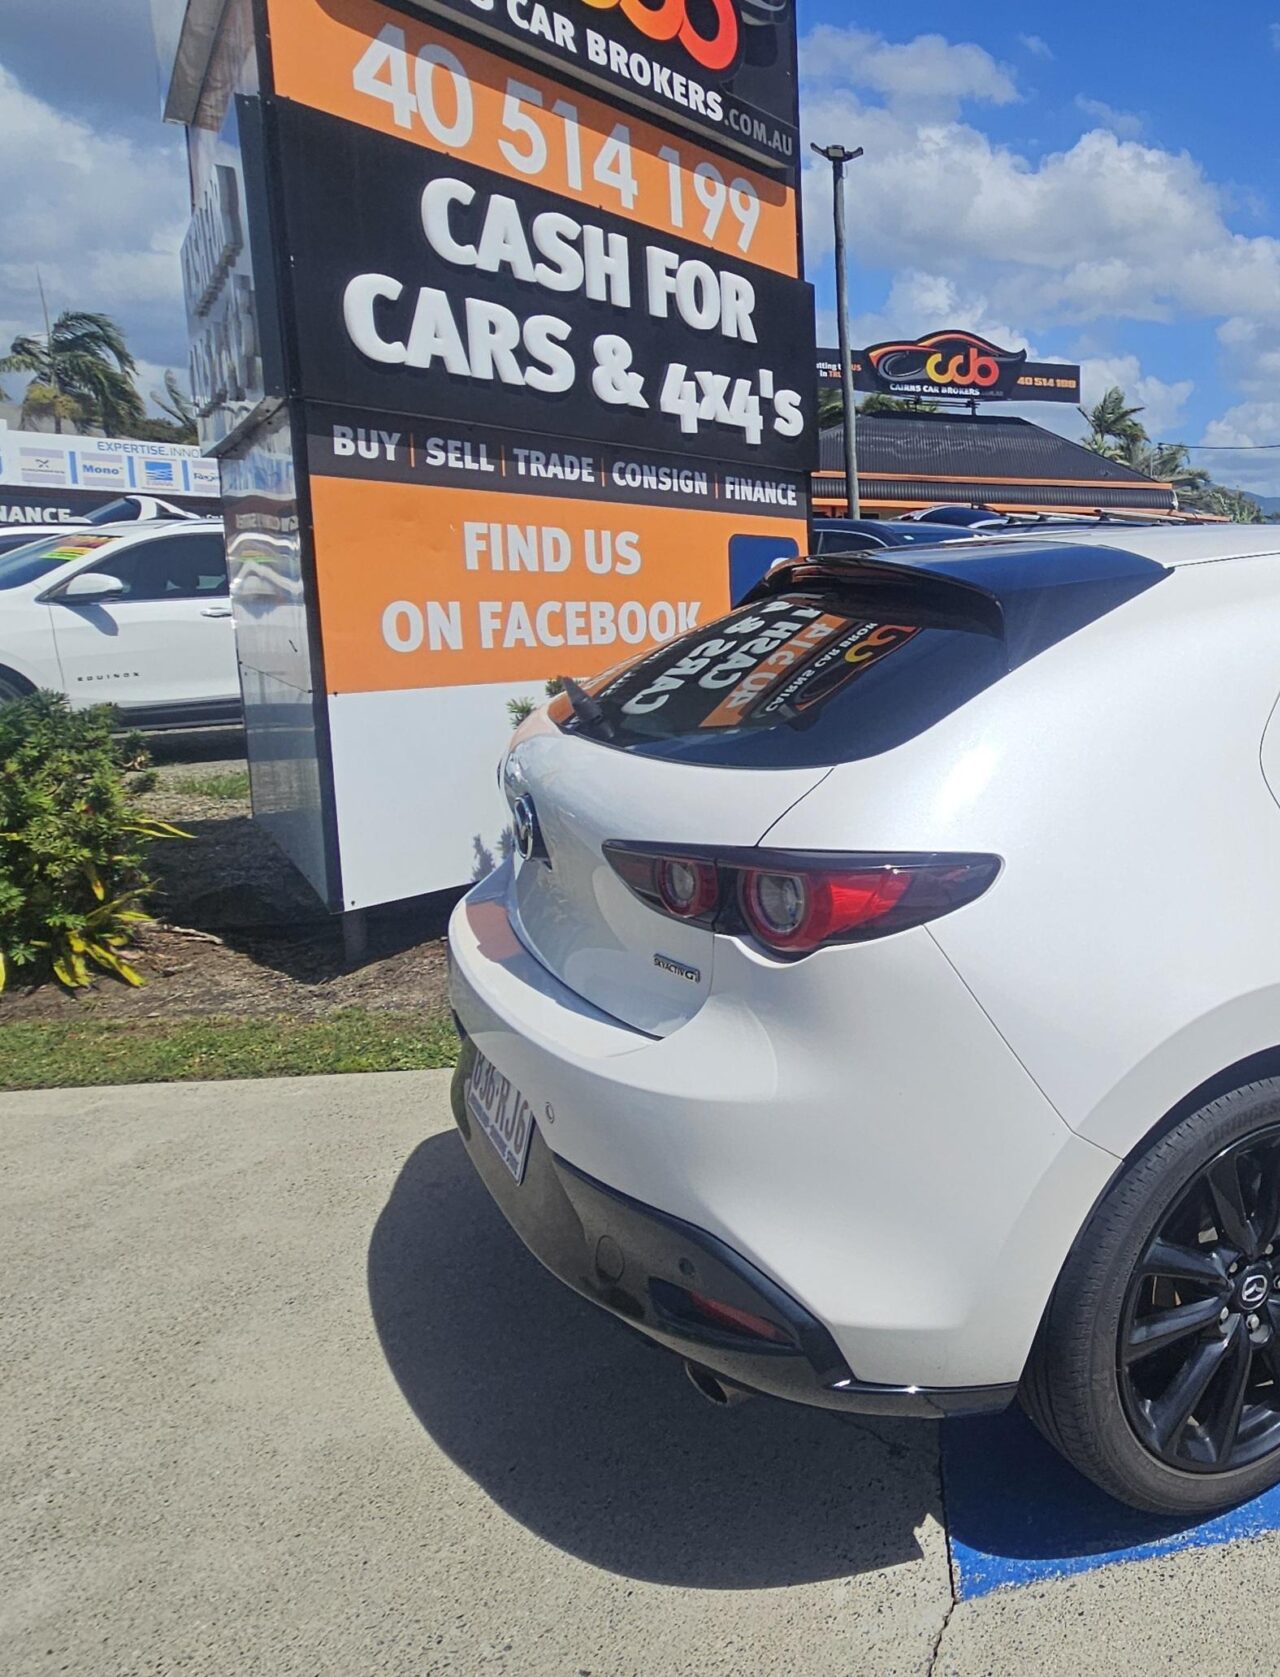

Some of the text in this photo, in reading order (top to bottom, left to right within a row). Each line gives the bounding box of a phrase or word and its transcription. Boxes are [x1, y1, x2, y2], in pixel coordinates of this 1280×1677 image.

[505, 0, 578, 53] CAR
[352, 23, 473, 149] 40
[497, 77, 638, 210] 514
[657, 145, 761, 253] 199
[421, 177, 758, 344] CASH FOR
[343, 272, 576, 393] CARS
[592, 334, 650, 409] &
[922, 384, 940, 393] CAR
[332, 425, 798, 507] BUY SELL TRADE CONSIGN FINANCE
[463, 520, 642, 575] FIND US
[382, 599, 701, 652] ON FACEBOOK
[77, 671, 139, 681] EQUINOX
